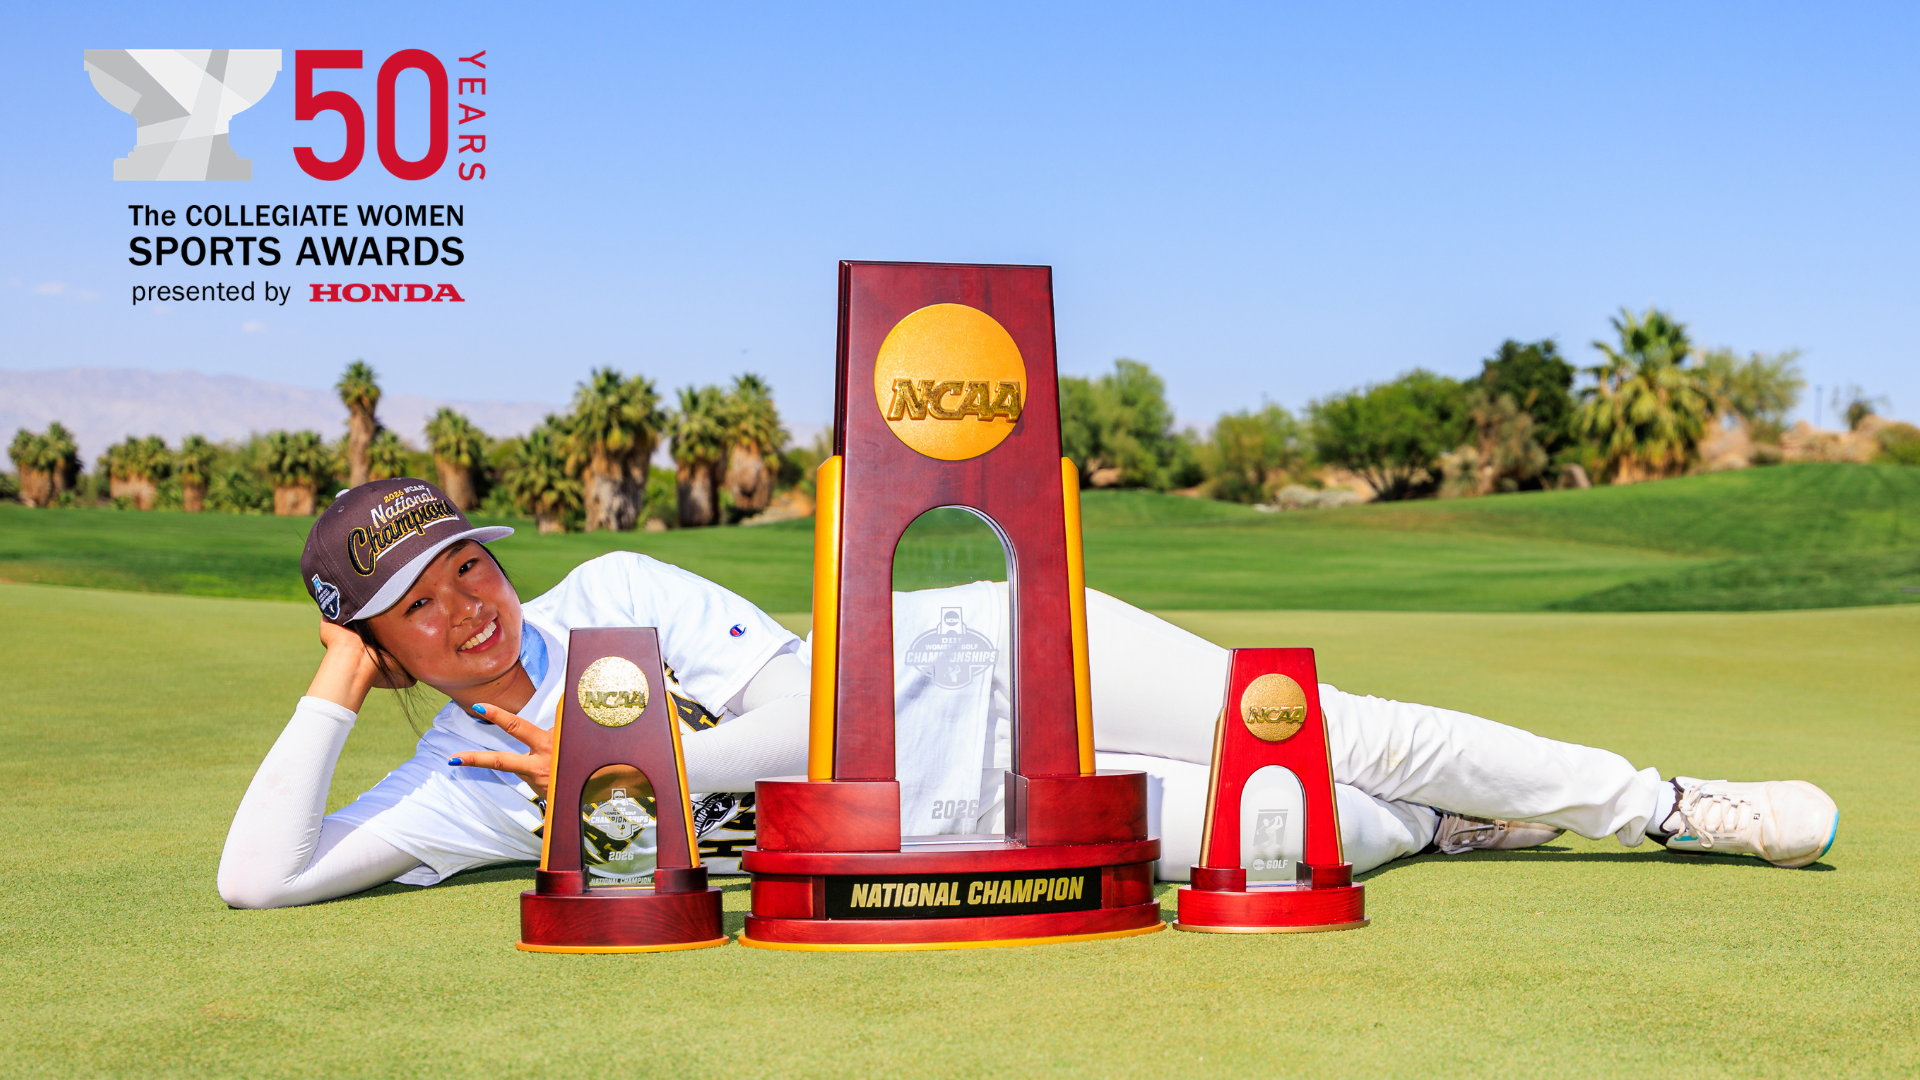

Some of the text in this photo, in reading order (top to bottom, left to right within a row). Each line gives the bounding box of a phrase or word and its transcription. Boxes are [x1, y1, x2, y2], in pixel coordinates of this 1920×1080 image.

[887, 378, 1023, 423] NCAA
[383, 489, 405, 503] 2026
[370, 487, 437, 528] National
[347, 500, 456, 576] Champions
[583, 690, 646, 708] NCAA
[1247, 705, 1304, 723] NCAA
[931, 799, 979, 819] 2026
[608, 850, 635, 861] 2026
[1265, 859, 1289, 869] GOLF
[620, 876, 652, 884] CHAMPION
[850, 876, 1085, 908] NATIONAL CHAMPION
